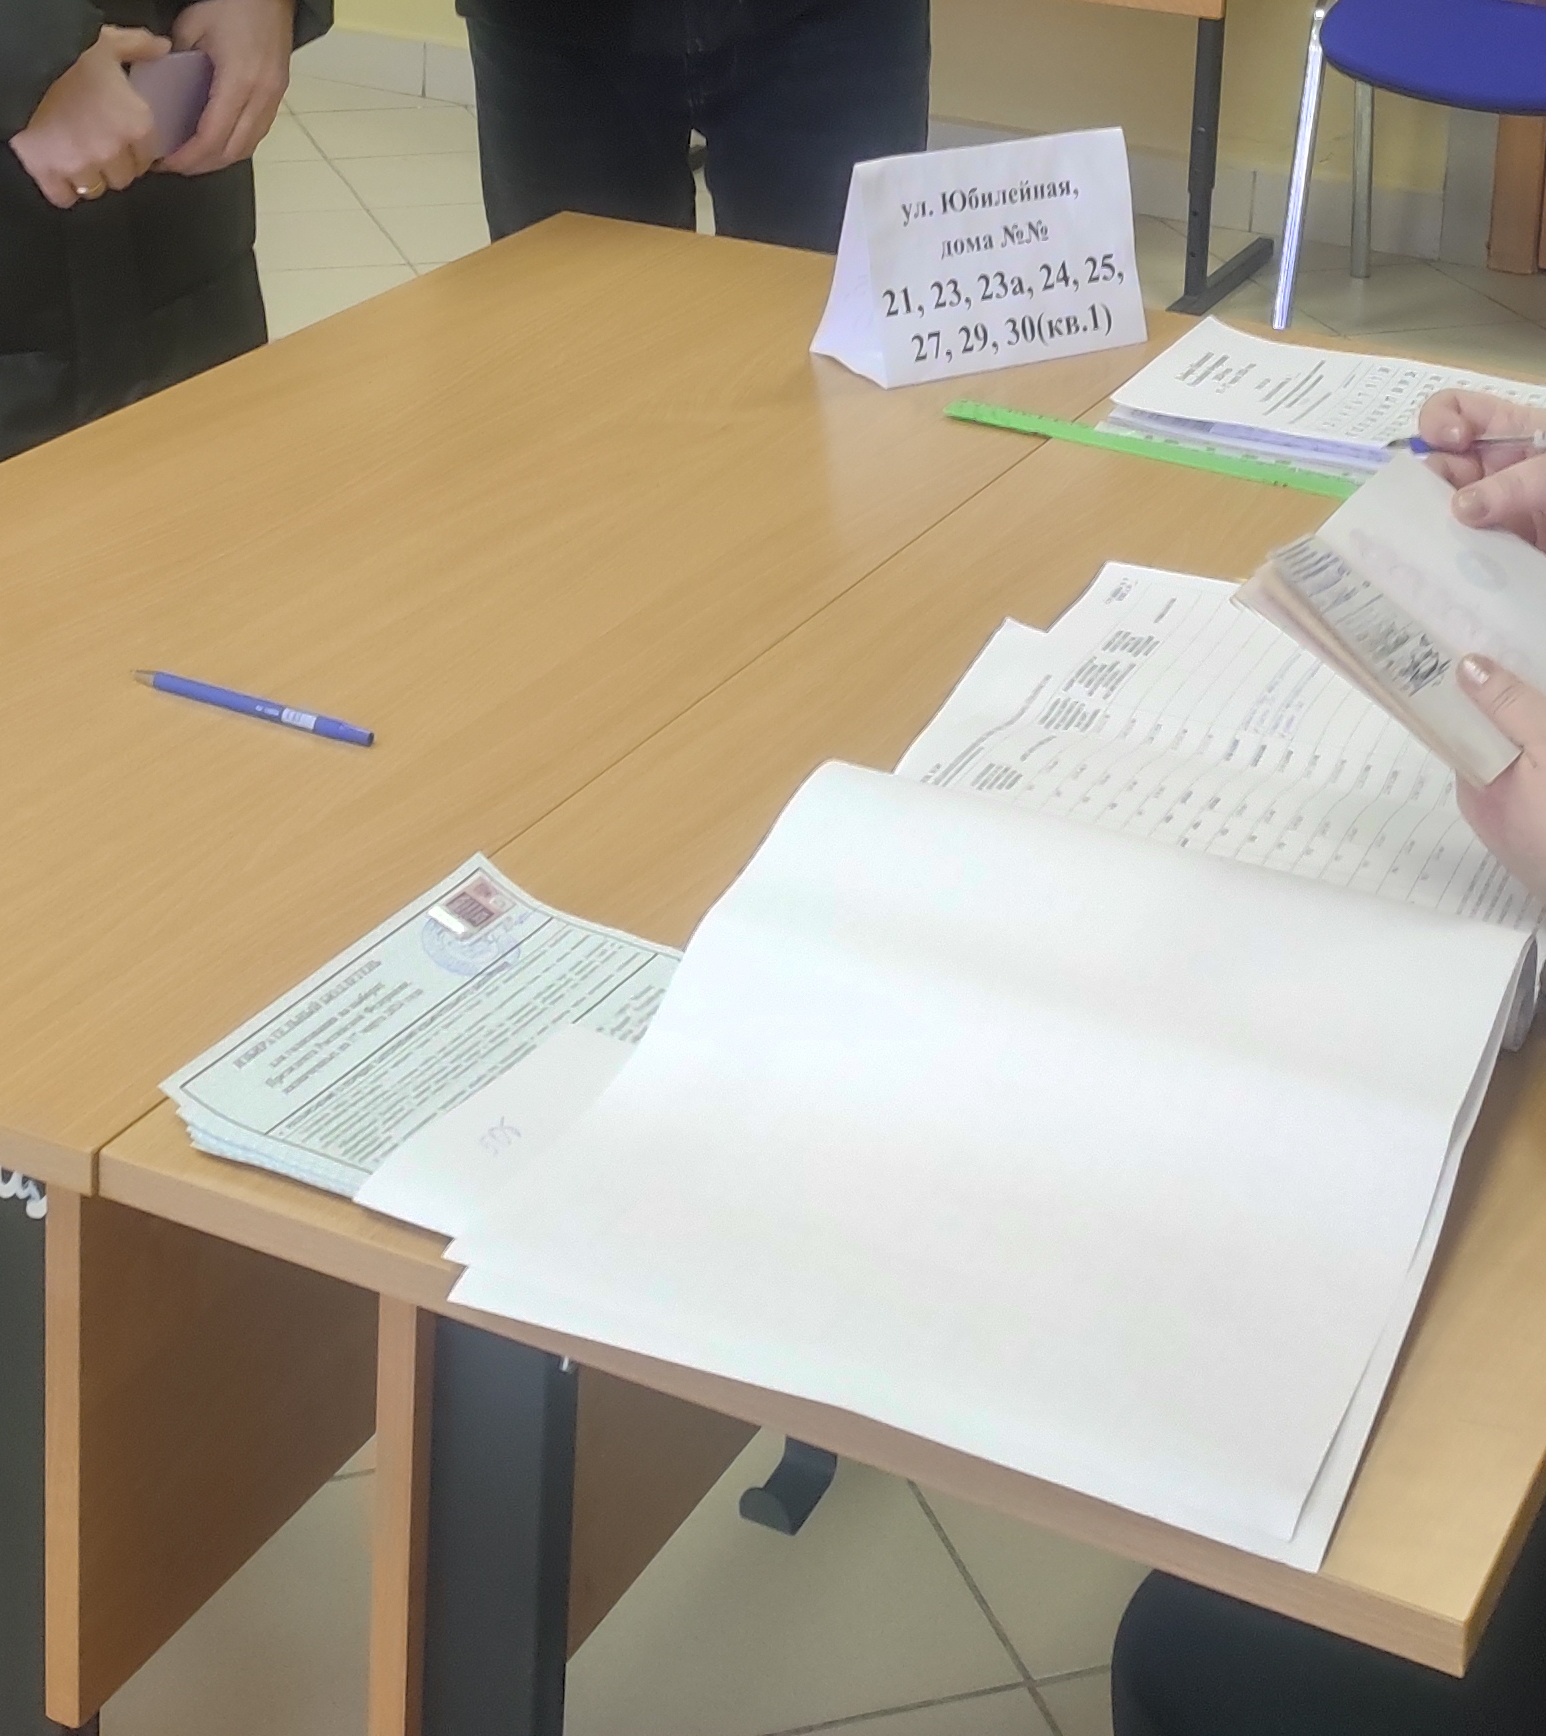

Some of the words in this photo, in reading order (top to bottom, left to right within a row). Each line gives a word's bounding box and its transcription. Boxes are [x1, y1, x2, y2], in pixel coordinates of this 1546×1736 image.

[901, 202, 934, 227] ул.
[941, 180, 1079, 214] Юбилейная,
[941, 233, 994, 260] дома
[1000, 219, 1049, 248] №№
[882, 287, 925, 318] 21,
[930, 278, 972, 310] 23,
[977, 271, 1034, 300] 23а,
[1039, 260, 1079, 292] 24,
[1084, 253, 1125, 284] 25,
[911, 330, 953, 363] 27,
[958, 323, 1000, 354] 29,
[1005, 303, 1113, 347] 30(кв.1)
